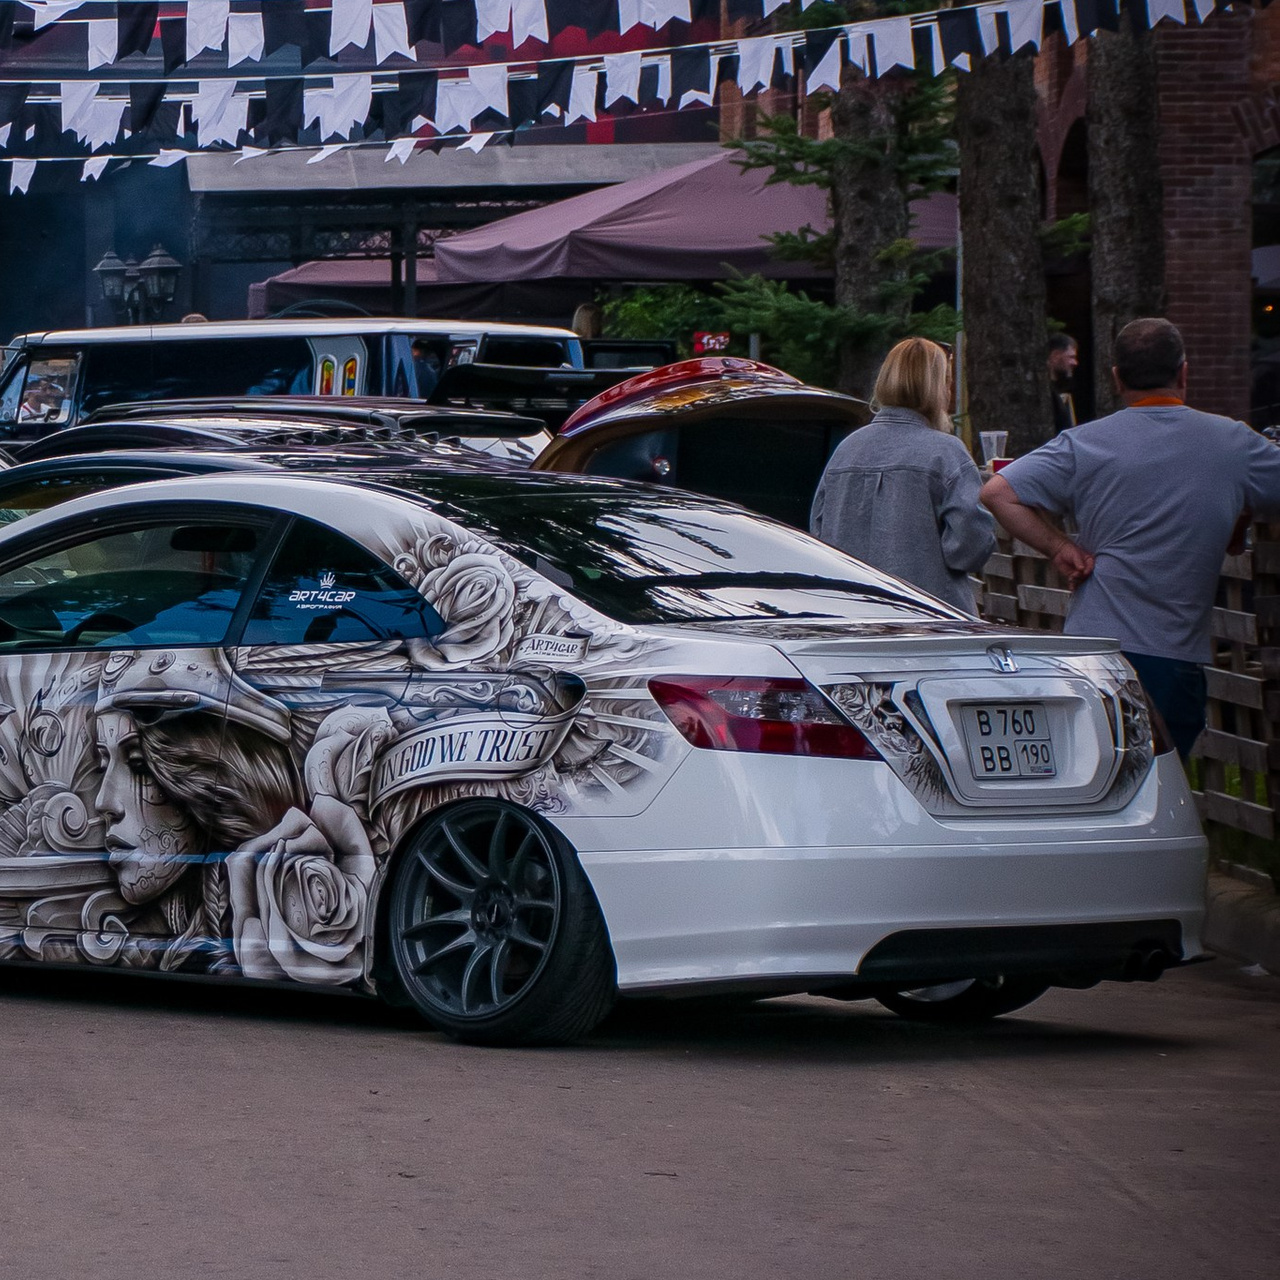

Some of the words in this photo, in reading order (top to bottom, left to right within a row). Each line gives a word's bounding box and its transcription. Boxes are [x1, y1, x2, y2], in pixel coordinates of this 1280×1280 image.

[996, 709, 1036, 736] 760
[398, 736, 437, 777] GOD
[438, 730, 473, 764] WE
[474, 729, 554, 762] TRUST
[1021, 744, 1050, 764] 190
